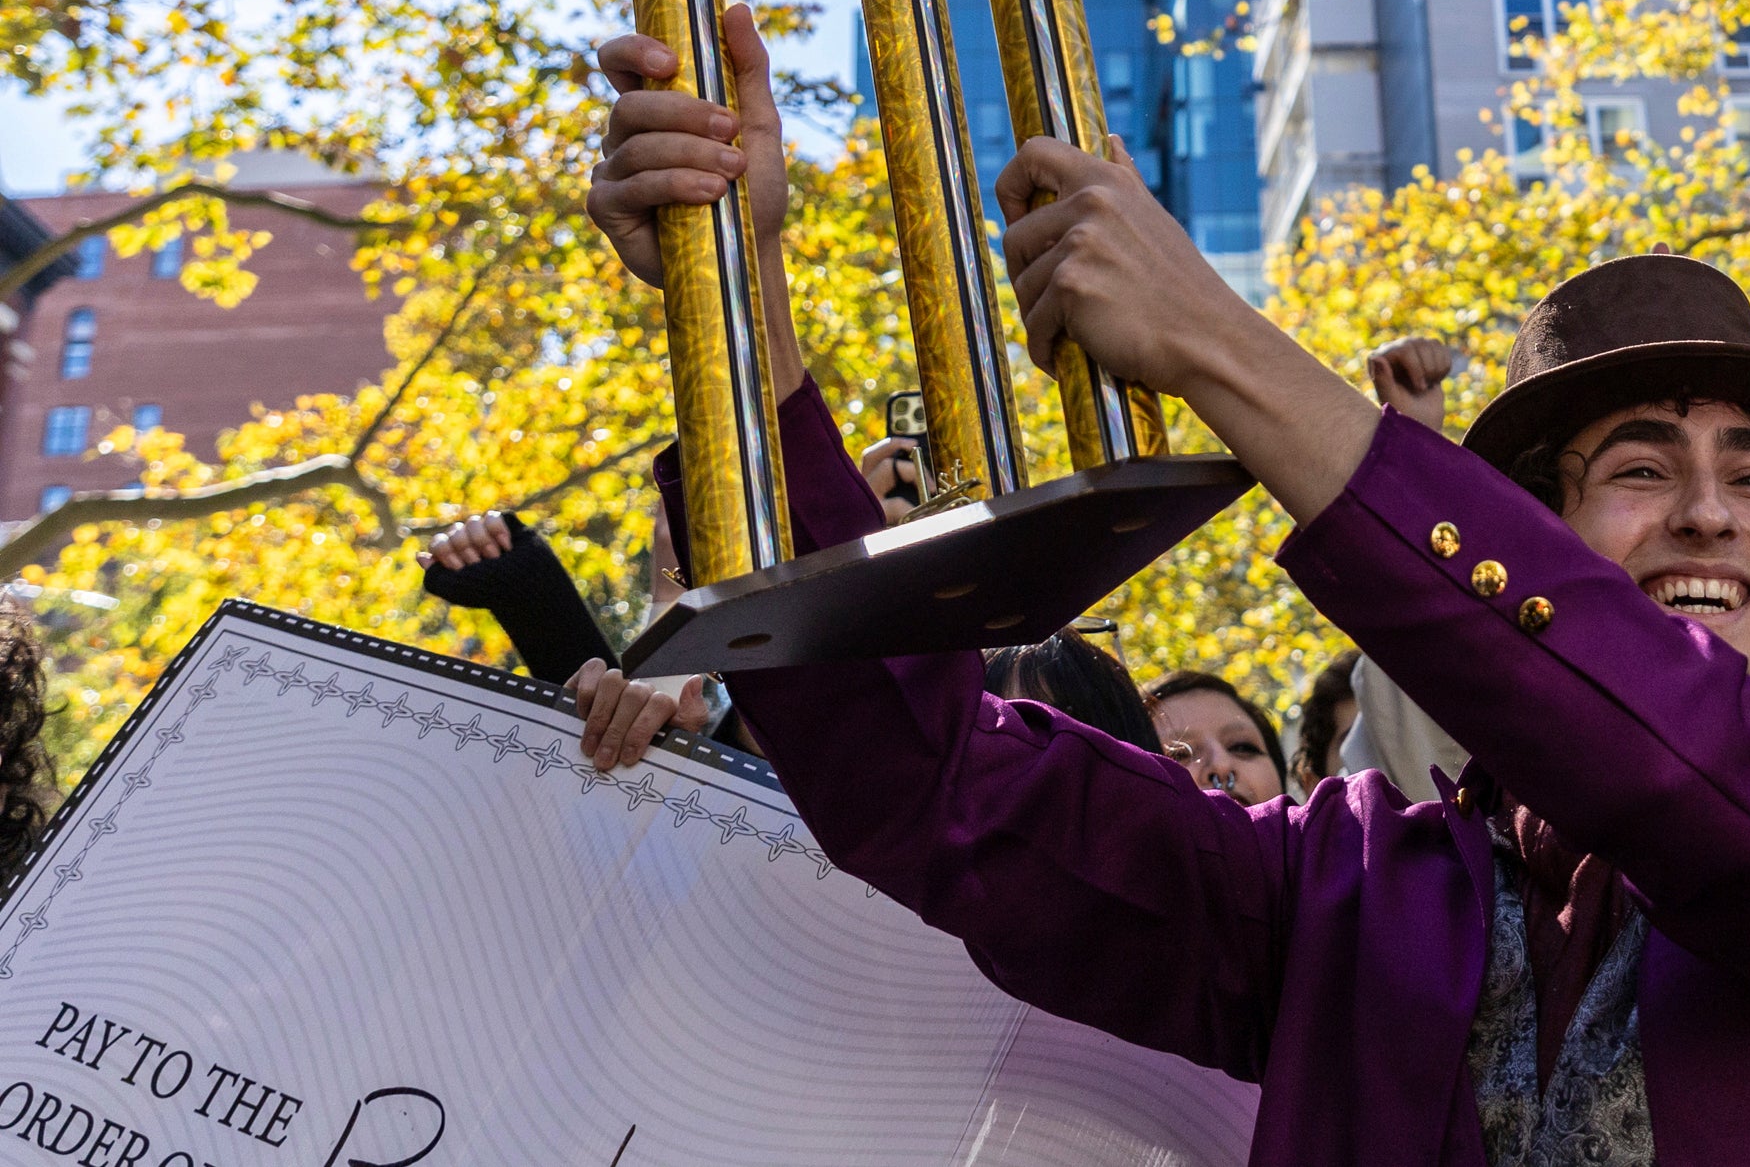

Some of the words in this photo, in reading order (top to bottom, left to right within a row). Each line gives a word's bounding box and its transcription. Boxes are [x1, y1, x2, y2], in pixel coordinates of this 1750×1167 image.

[0, 1081, 151, 1167] ORDER
[34, 1001, 133, 1071] PAY
[120, 1032, 194, 1100] TO
[193, 1062, 304, 1149] THE
